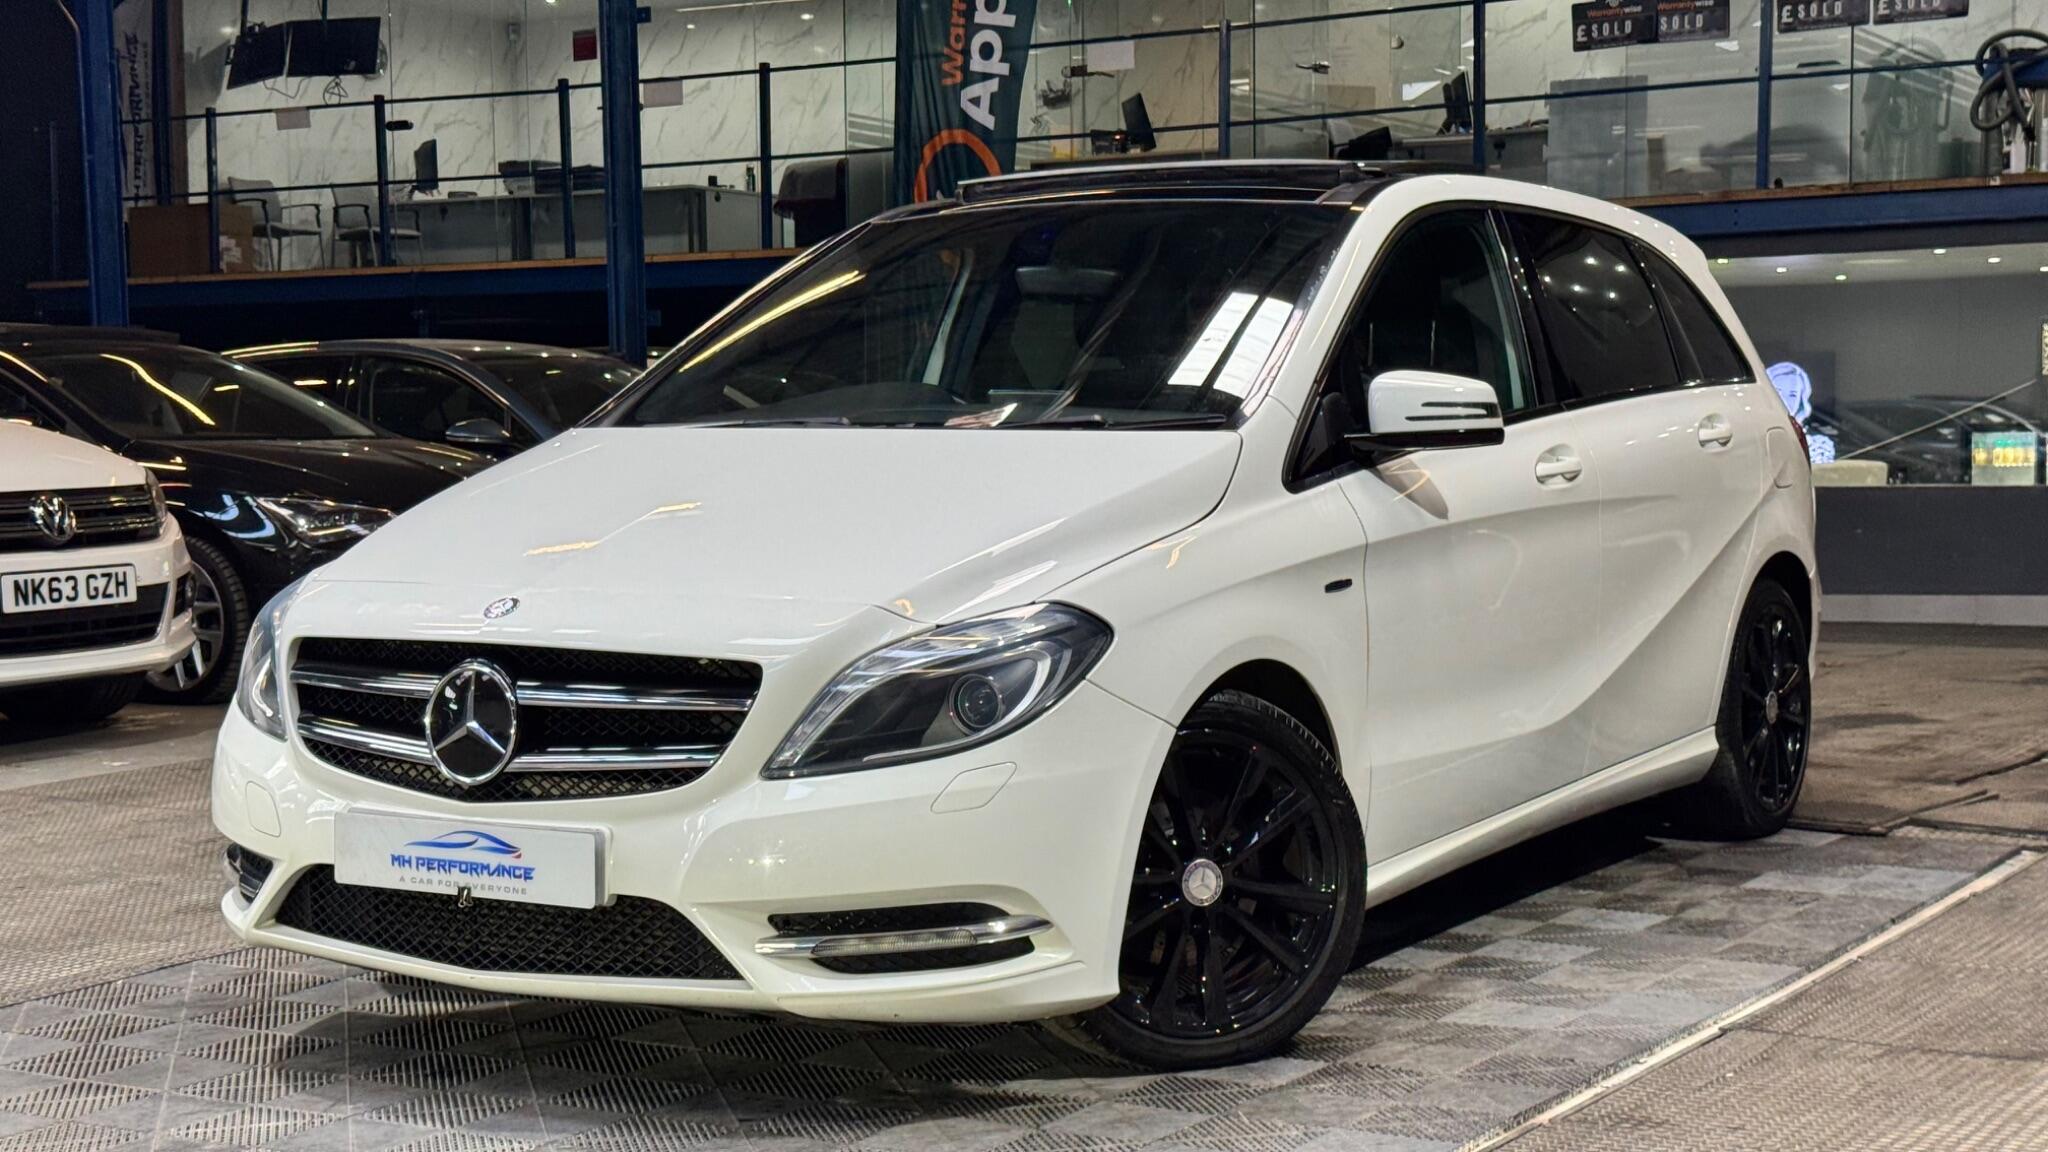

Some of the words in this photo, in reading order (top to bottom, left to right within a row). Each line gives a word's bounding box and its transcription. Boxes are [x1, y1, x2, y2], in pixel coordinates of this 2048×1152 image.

[1797, 1, 1842, 19] SOLD
[1591, 19, 1632, 39] SOLD
[1660, 13, 1704, 32] SOLD
[13, 575, 79, 607] NK63
[85, 571, 128, 600] GZH
[390, 854, 412, 869] MH
[415, 856, 536, 882] PERFORMANCE
[410, 876, 433, 886] CAR
